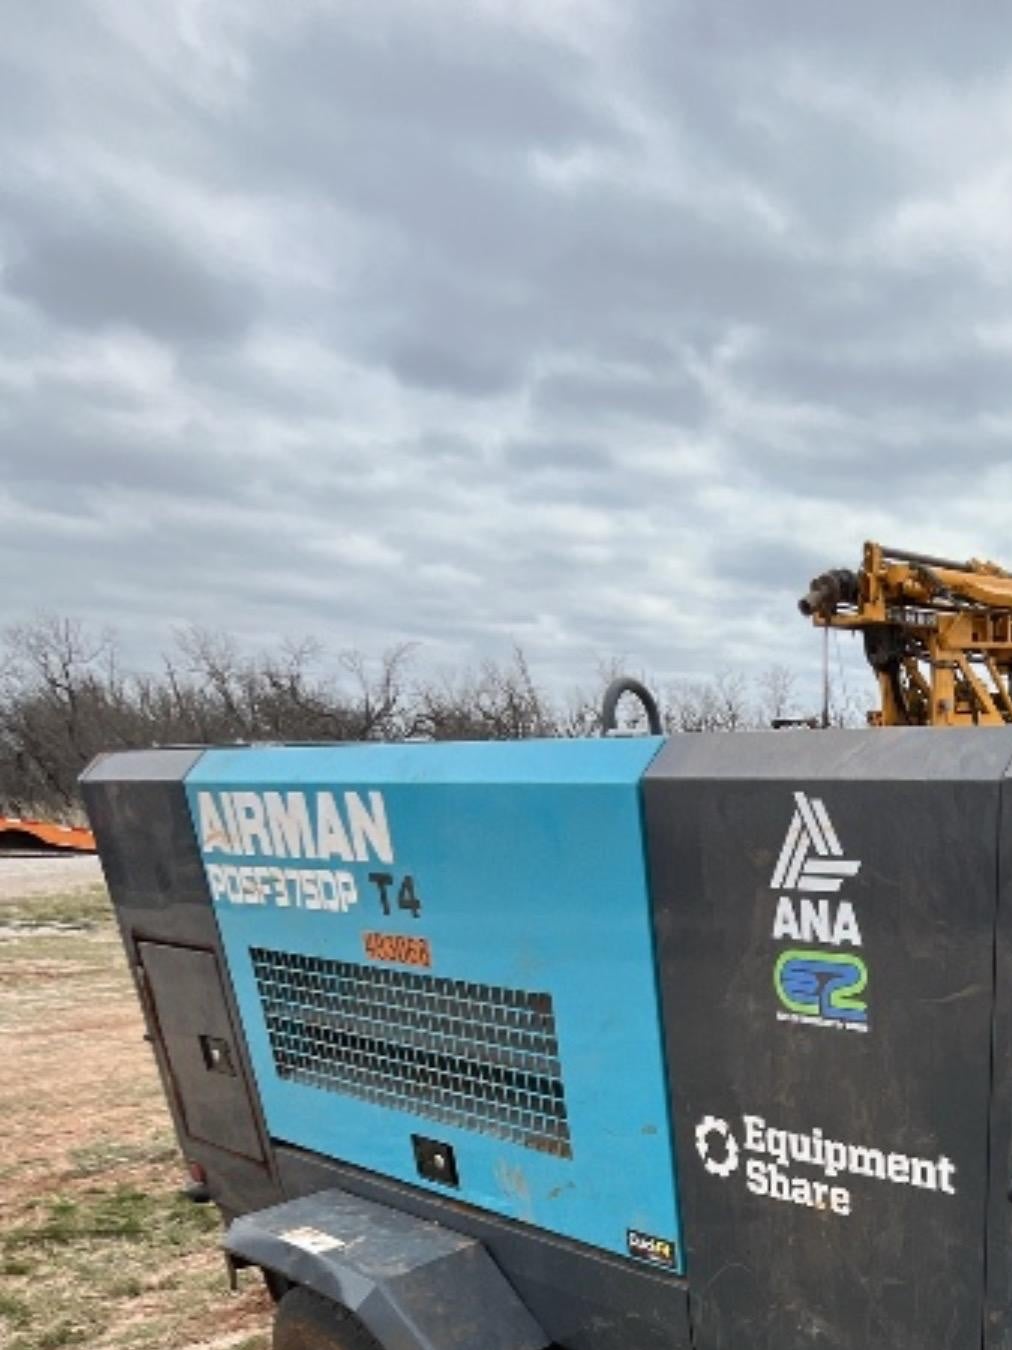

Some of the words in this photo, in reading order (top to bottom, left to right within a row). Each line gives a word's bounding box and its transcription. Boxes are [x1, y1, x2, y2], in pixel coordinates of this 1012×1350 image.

[198, 791, 394, 865] AIRMAN
[368, 872, 422, 919] T4
[773, 896, 862, 946] ANA
[743, 1114, 957, 1195] Equipment
[745, 1160, 851, 1216] Share
